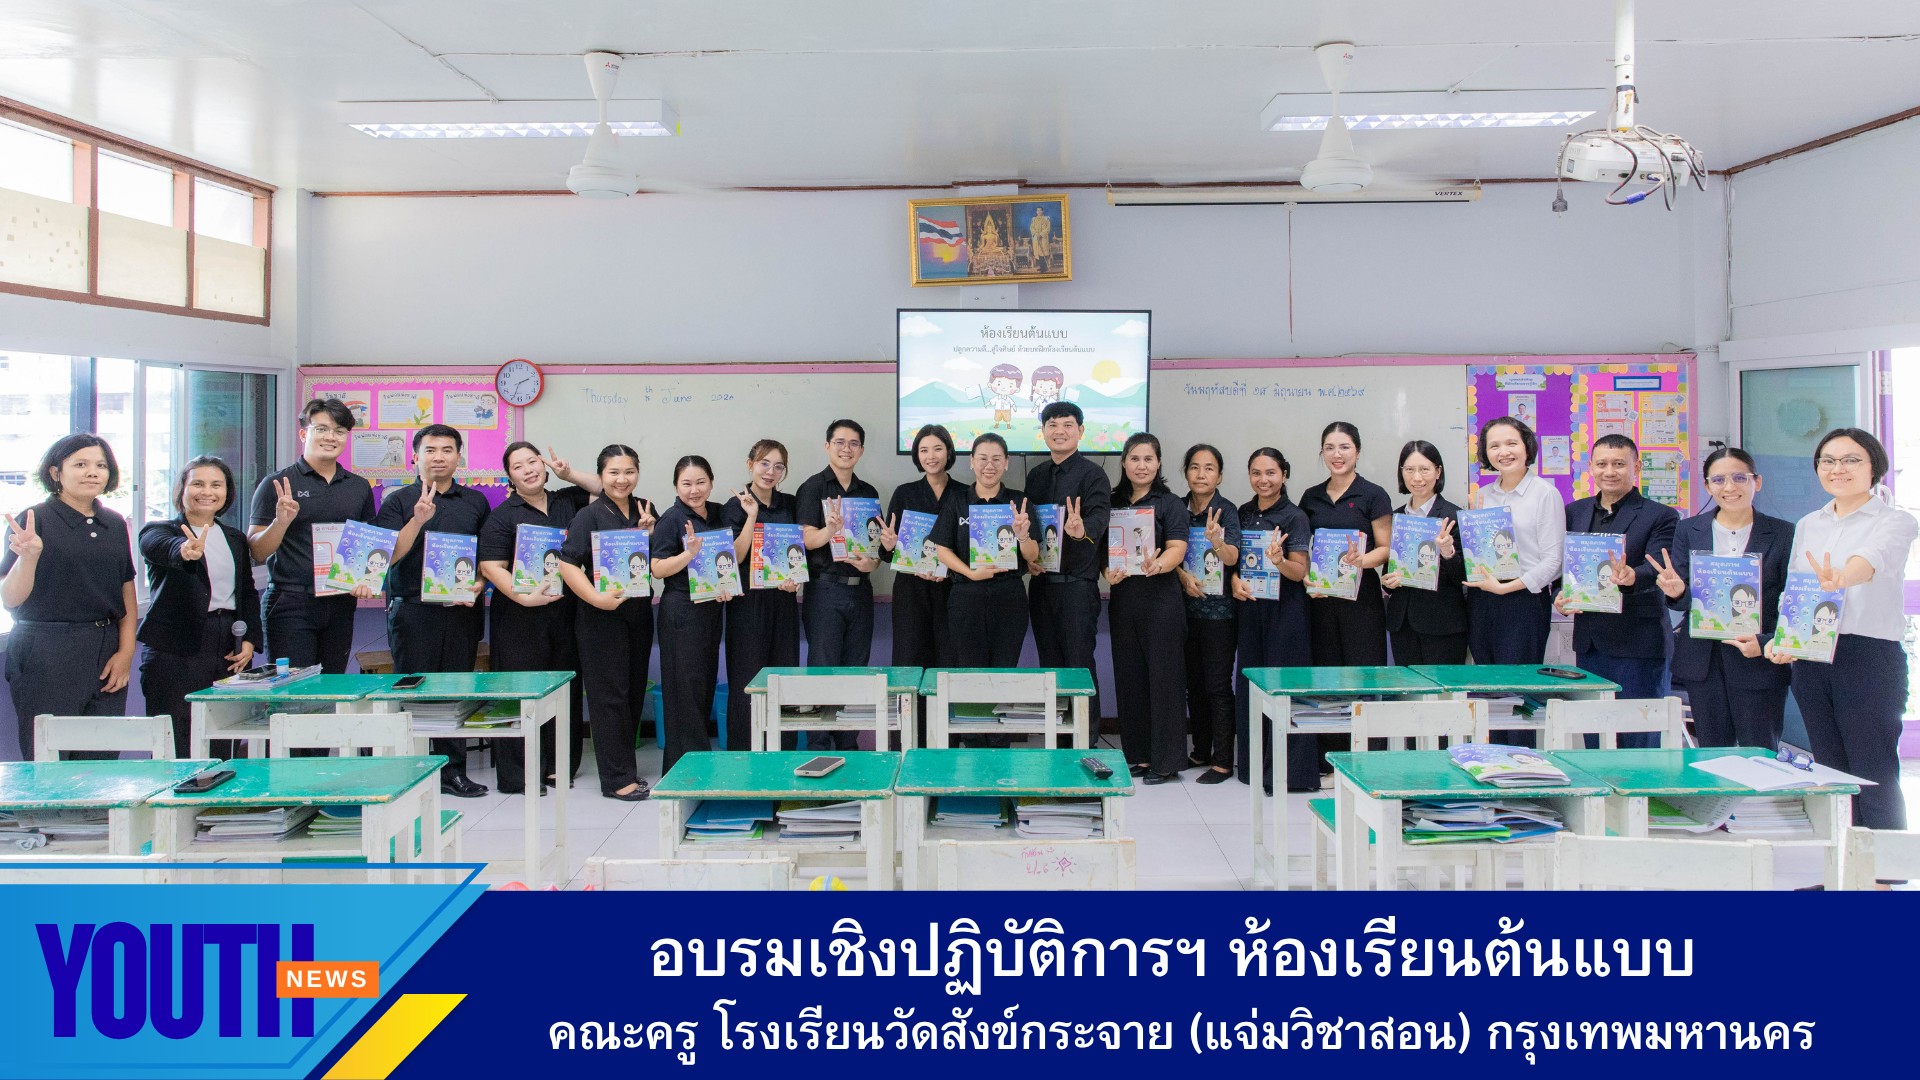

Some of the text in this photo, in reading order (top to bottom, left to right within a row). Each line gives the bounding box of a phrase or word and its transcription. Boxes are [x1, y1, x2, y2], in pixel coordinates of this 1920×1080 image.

[980, 325, 1068, 339] ห้องเรียนต้นแบบ
[660, 386, 692, 404] June
[1710, 561, 1740, 569] สมุดภาพ
